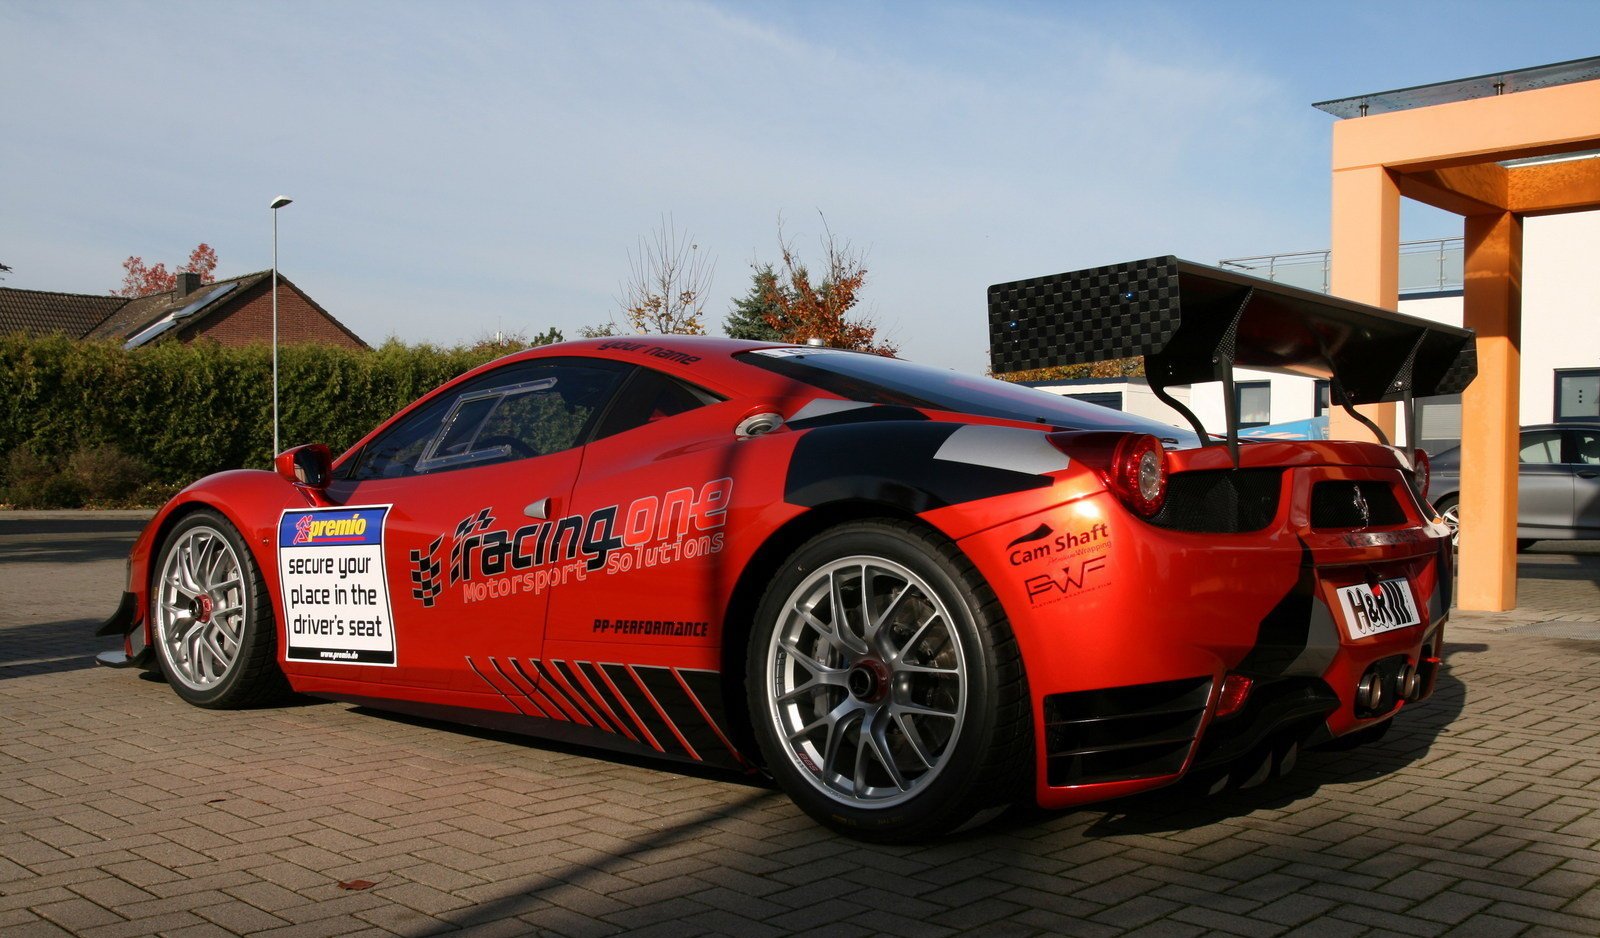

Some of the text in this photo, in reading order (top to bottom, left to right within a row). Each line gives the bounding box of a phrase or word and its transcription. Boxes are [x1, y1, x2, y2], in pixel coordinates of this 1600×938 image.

[597, 341, 702, 365] your name
[308, 513, 367, 543] premio
[1009, 544, 1051, 566] Cam
[1055, 523, 1109, 552] Shaft
[288, 557, 371, 579] secure your
[463, 560, 587, 604] Motorsport
[291, 584, 377, 609] place in the
[293, 614, 383, 637] driver's seat
